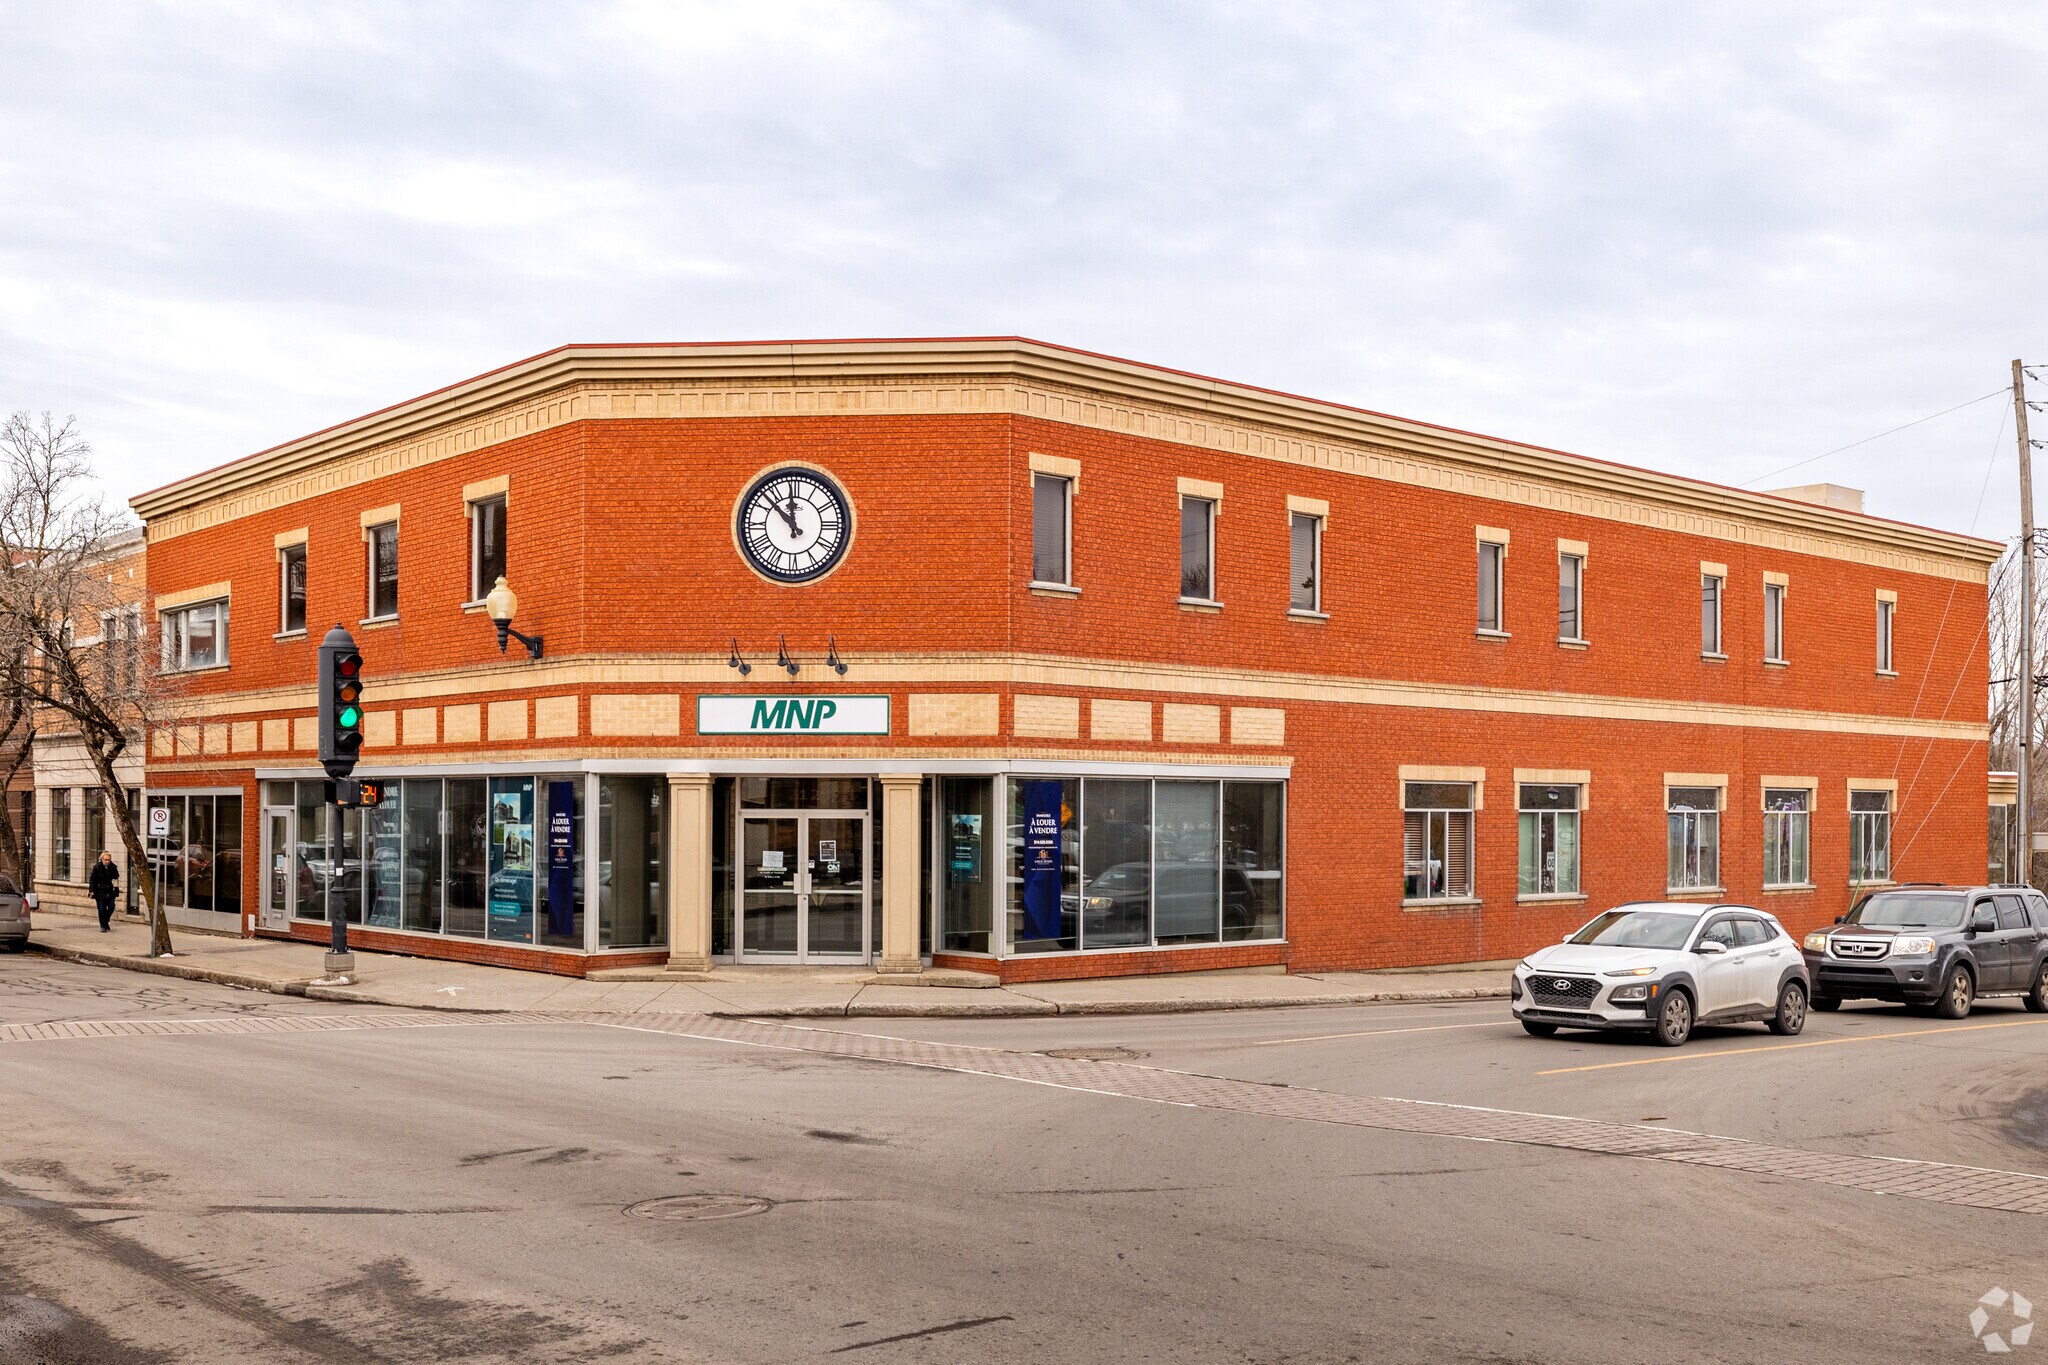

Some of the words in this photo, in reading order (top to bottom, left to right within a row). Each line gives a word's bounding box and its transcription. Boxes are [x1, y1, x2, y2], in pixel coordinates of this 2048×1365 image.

[750, 699, 836, 729] MNP
[362, 785, 377, 804] 24
[1031, 818, 1035, 826] À
[1029, 826, 1033, 834] À
